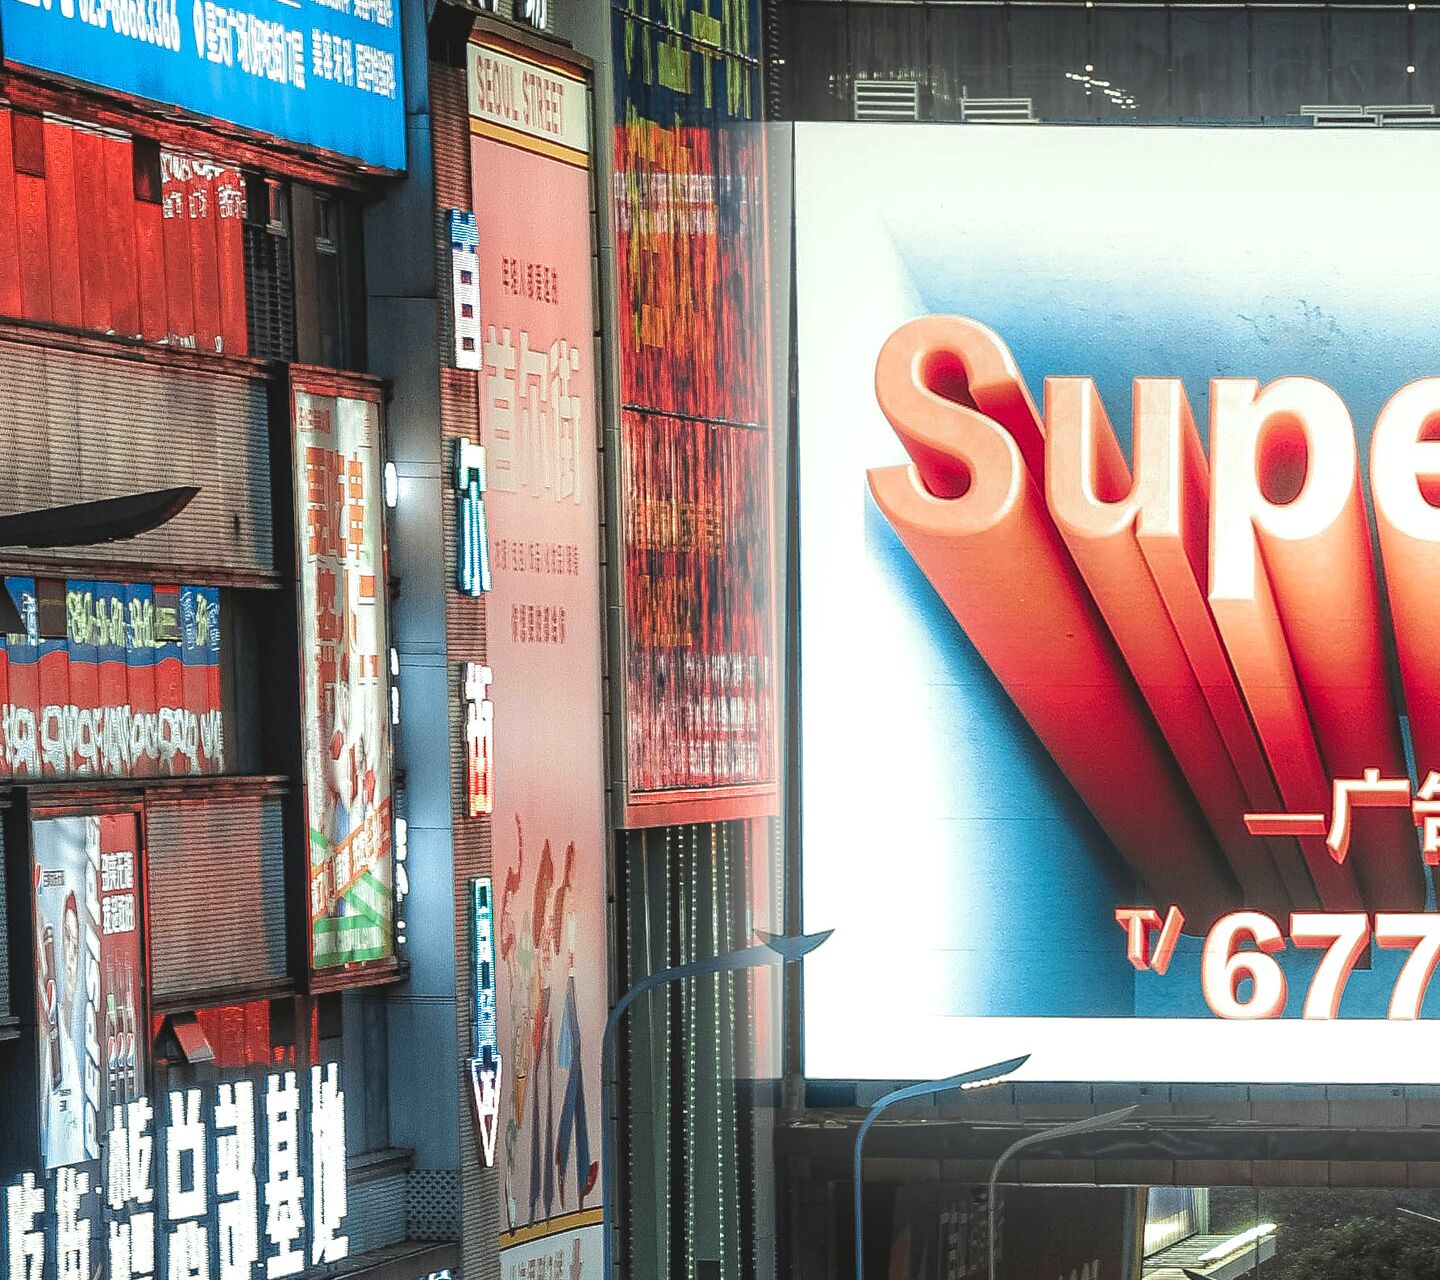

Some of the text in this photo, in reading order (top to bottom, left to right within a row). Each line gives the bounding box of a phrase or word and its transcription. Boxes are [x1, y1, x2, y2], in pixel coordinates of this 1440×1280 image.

[474, 53, 565, 138] SEOUL STREET
[484, 324, 583, 505] 首尔街
[84, 923, 102, 1160] PEPSI
